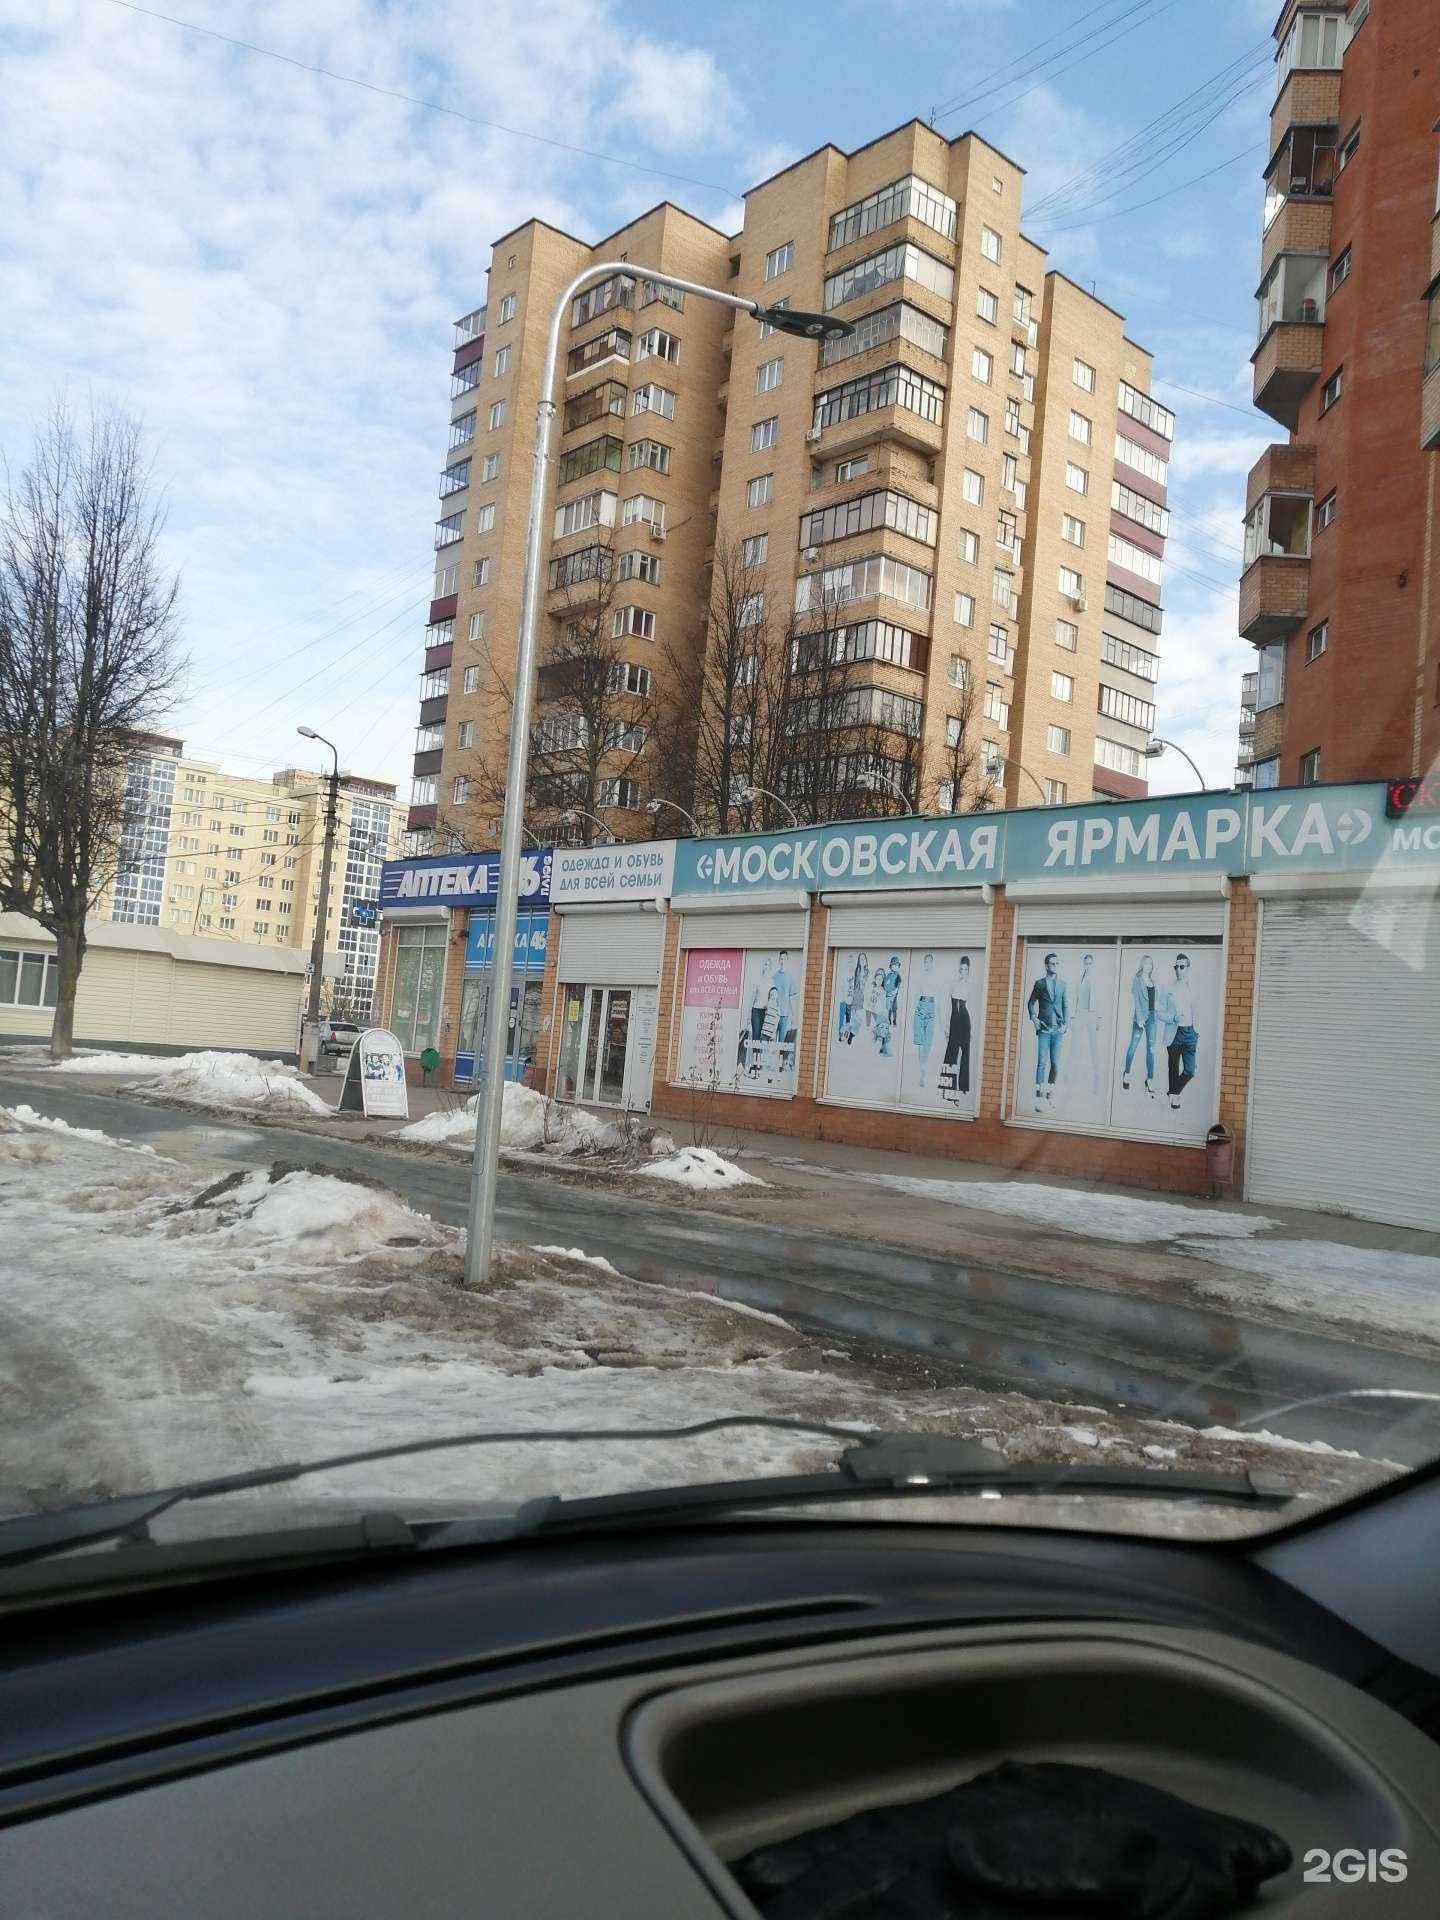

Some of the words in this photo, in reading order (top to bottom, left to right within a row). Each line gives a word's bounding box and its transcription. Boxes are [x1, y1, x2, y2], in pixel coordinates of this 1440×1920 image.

[713, 825, 998, 885] МОСКОВСКАЯ
[1044, 802, 1334, 867] ЯРМАРКА
[397, 865, 488, 898] АПТЕКА
[699, 959, 731, 971] ОДЕЖДА
[704, 974, 729, 984] ОБУВЬ
